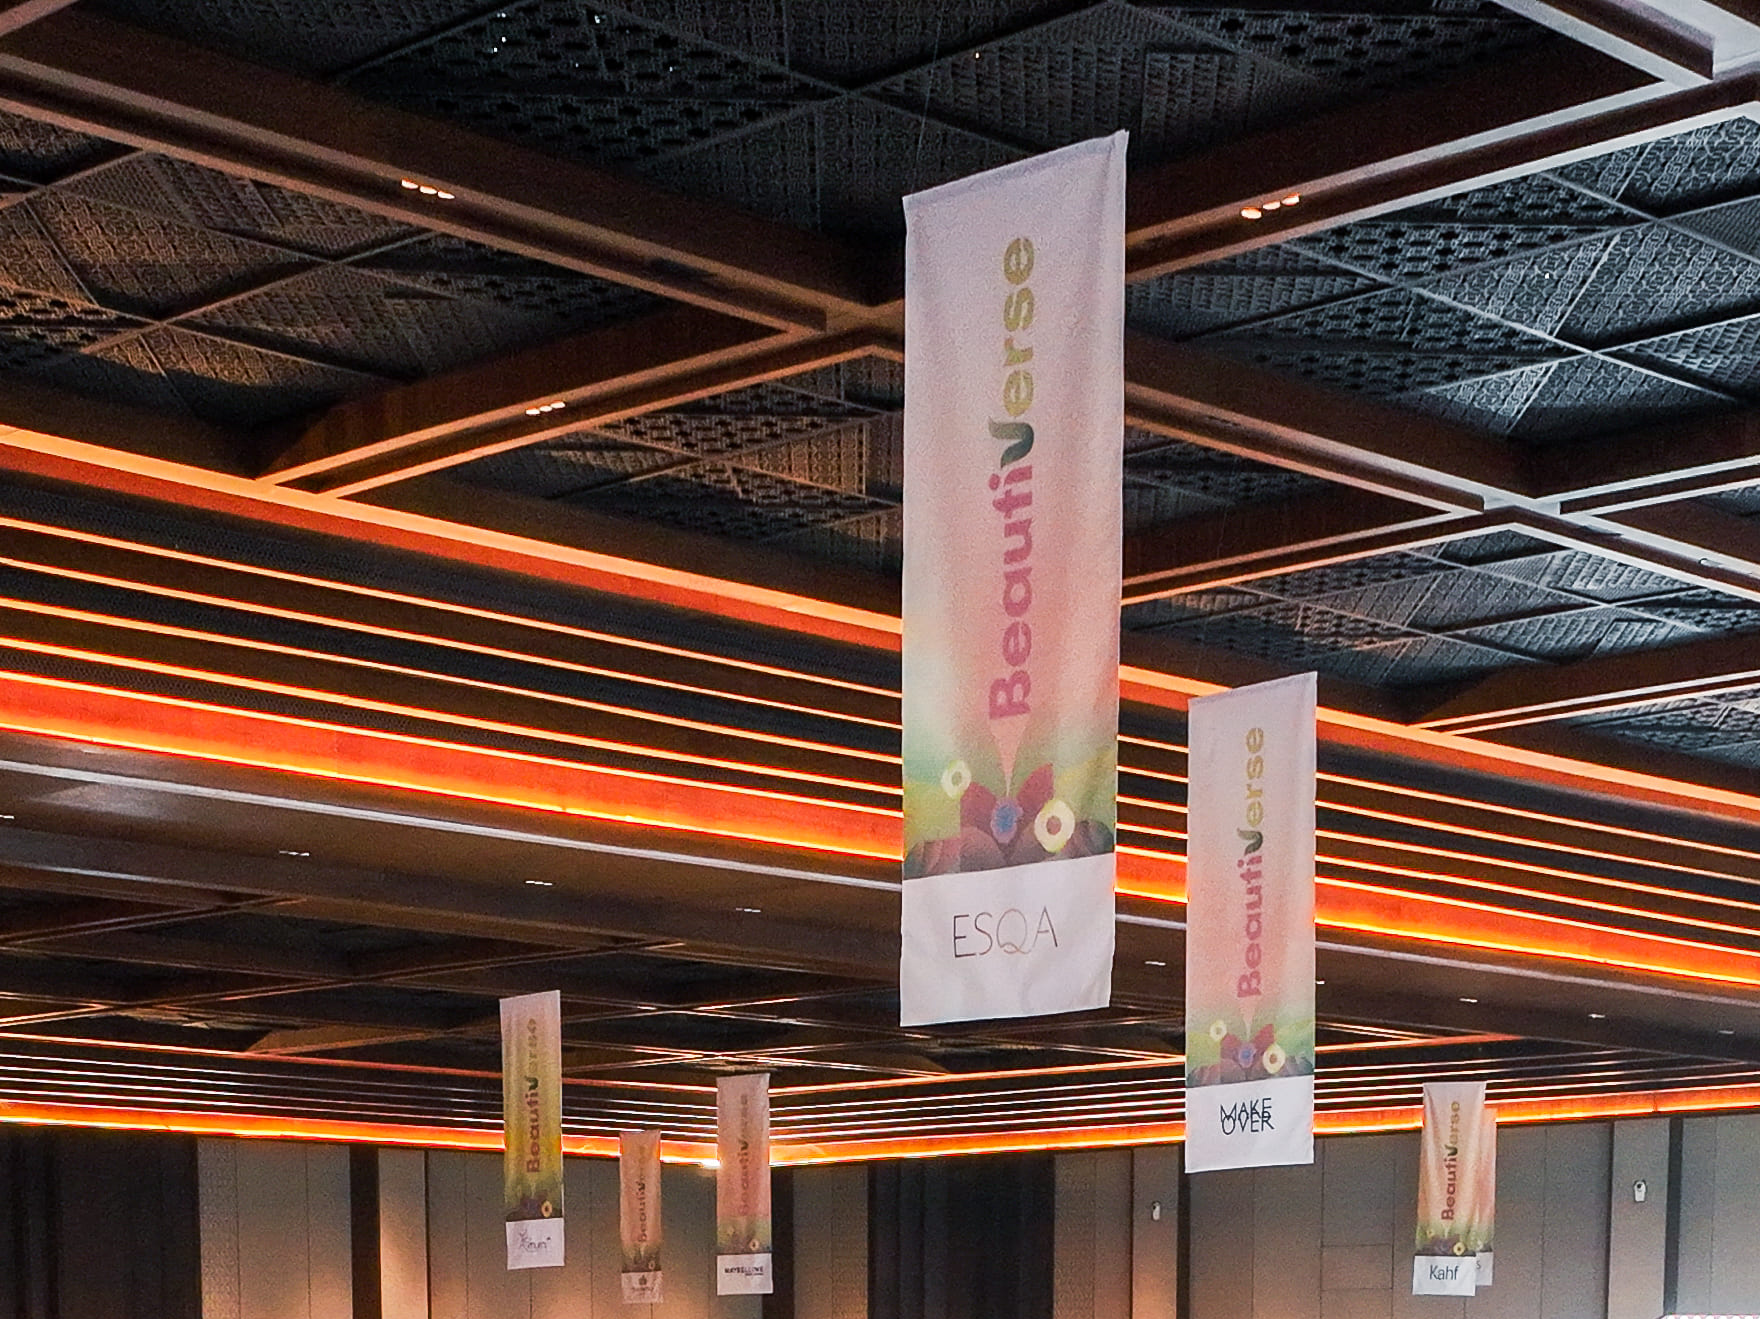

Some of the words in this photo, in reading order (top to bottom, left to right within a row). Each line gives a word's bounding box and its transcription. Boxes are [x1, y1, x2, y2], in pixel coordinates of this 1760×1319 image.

[988, 236, 1036, 722] BeautiVerse
[1236, 724, 1266, 999] BeautiVerse
[951, 909, 1060, 960] ESQA
[1220, 1097, 1272, 1123] MAKE
[1221, 1111, 1275, 1136] OVER
[1440, 1100, 1462, 1222] BeautiVerse
[1428, 1264, 1460, 1281] Kahf
